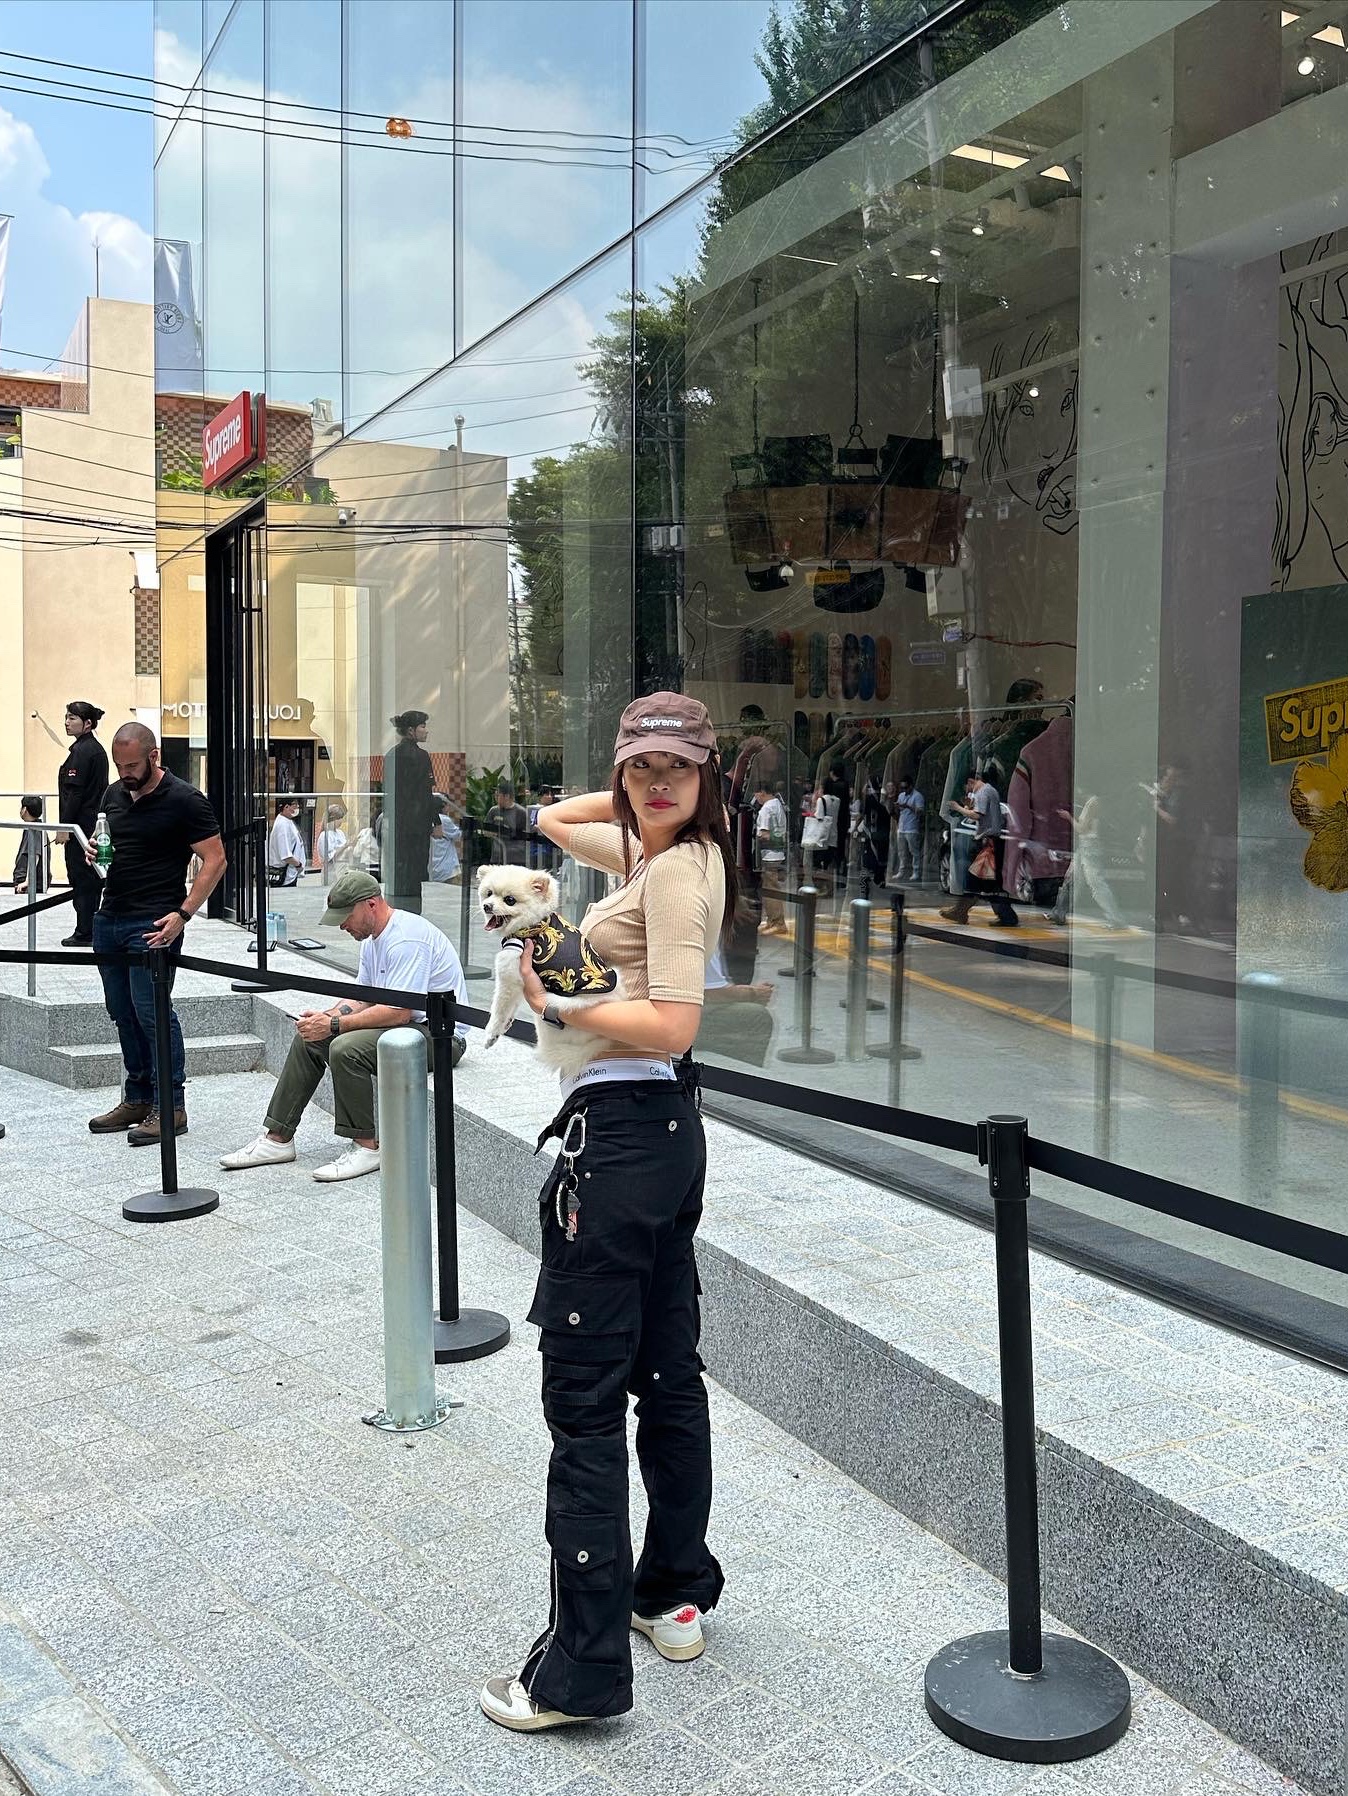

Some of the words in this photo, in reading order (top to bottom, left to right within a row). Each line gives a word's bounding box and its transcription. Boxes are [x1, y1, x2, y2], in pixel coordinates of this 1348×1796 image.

[205, 414, 241, 475] Supreme
[641, 717, 682, 729] Supreme
[1281, 697, 1348, 748] Sup
